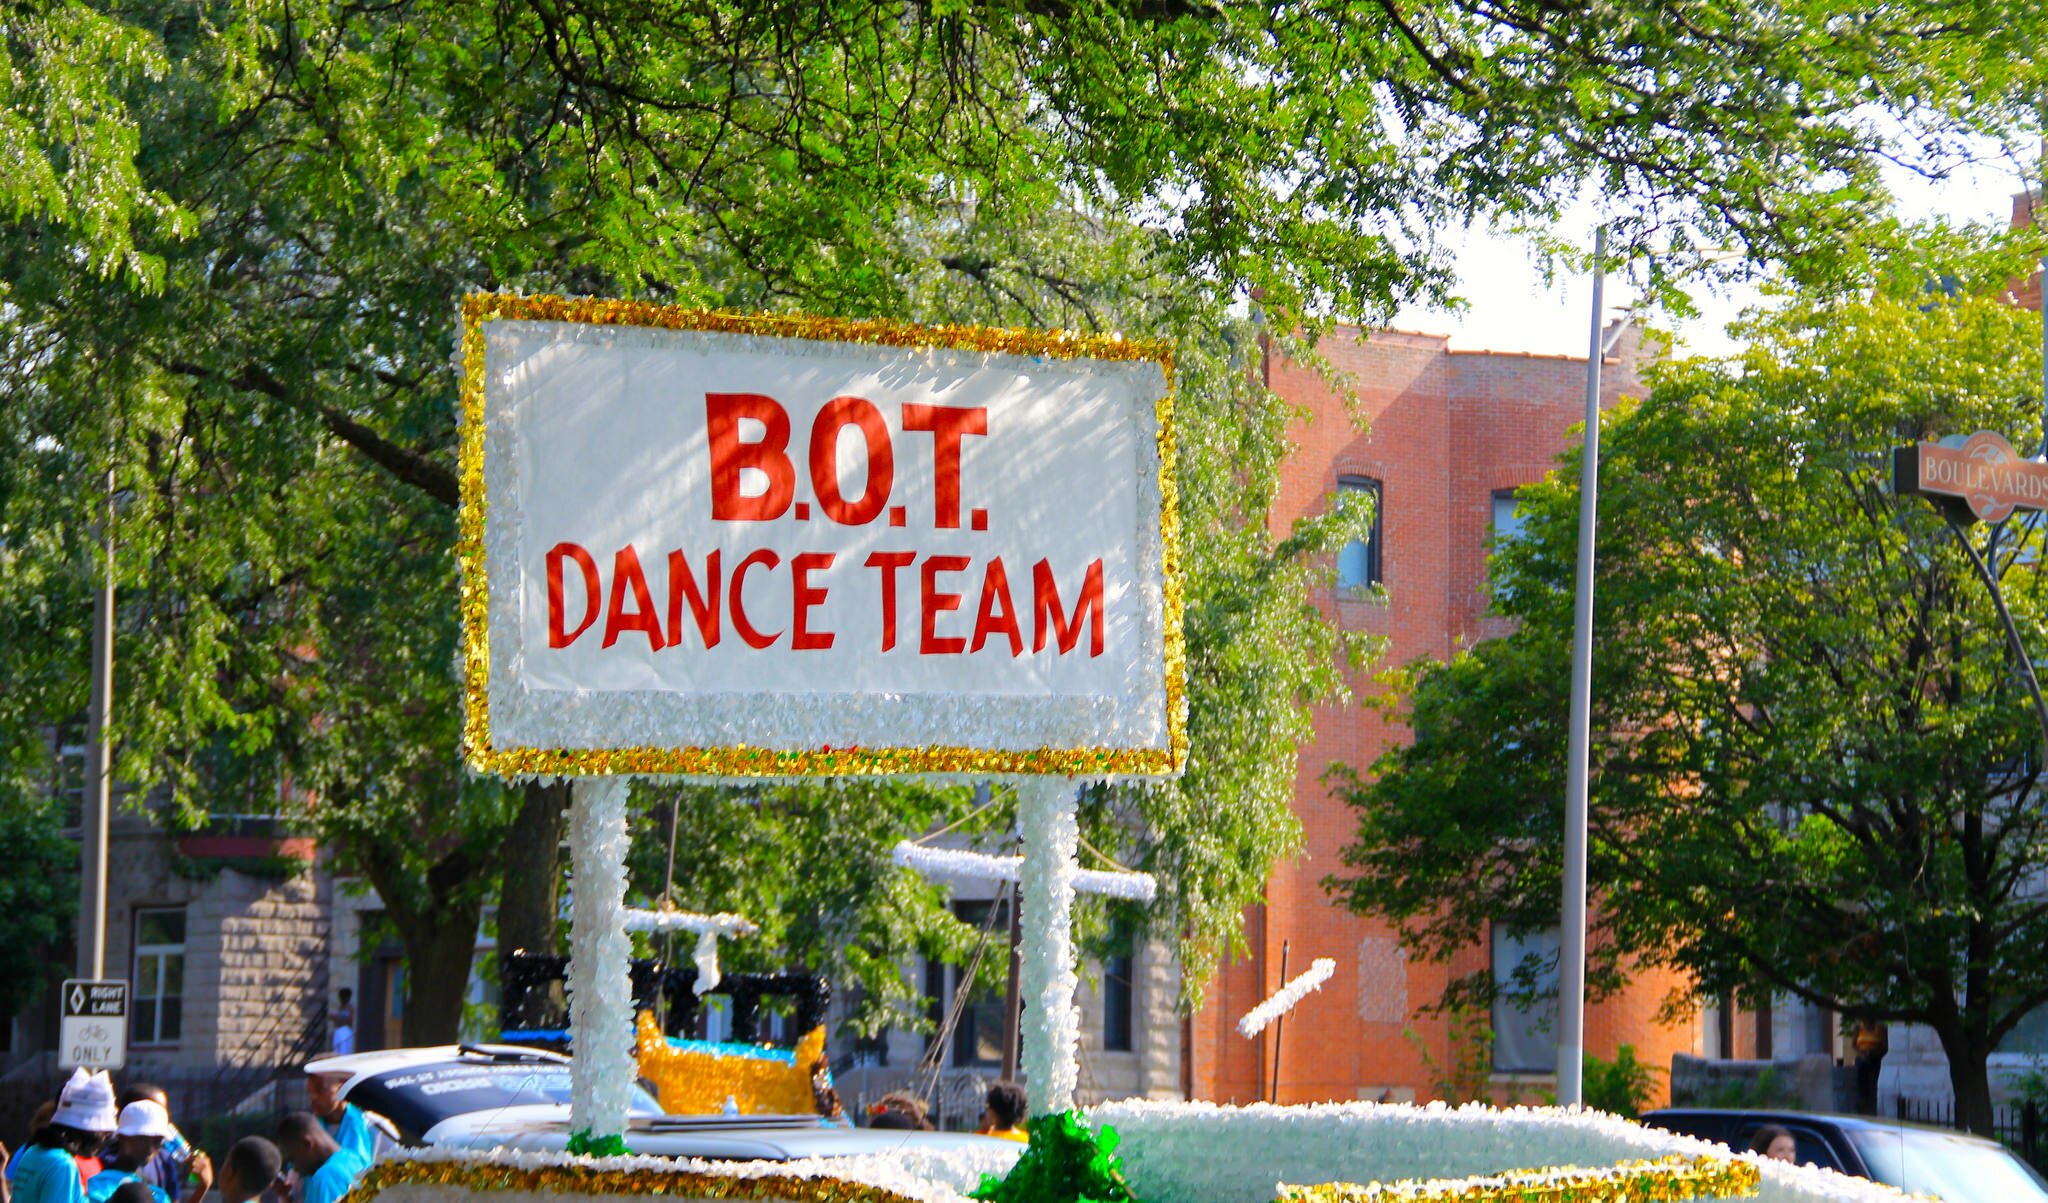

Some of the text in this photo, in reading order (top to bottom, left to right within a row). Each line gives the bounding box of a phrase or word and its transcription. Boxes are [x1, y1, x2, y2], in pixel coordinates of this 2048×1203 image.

[705, 392, 989, 531] B.O.T.
[546, 541, 1104, 658] DANCE TEAM
[90, 986, 124, 999] RIGHT
[91, 1001, 121, 1014] LANE
[72, 1045, 112, 1062] ONLY
